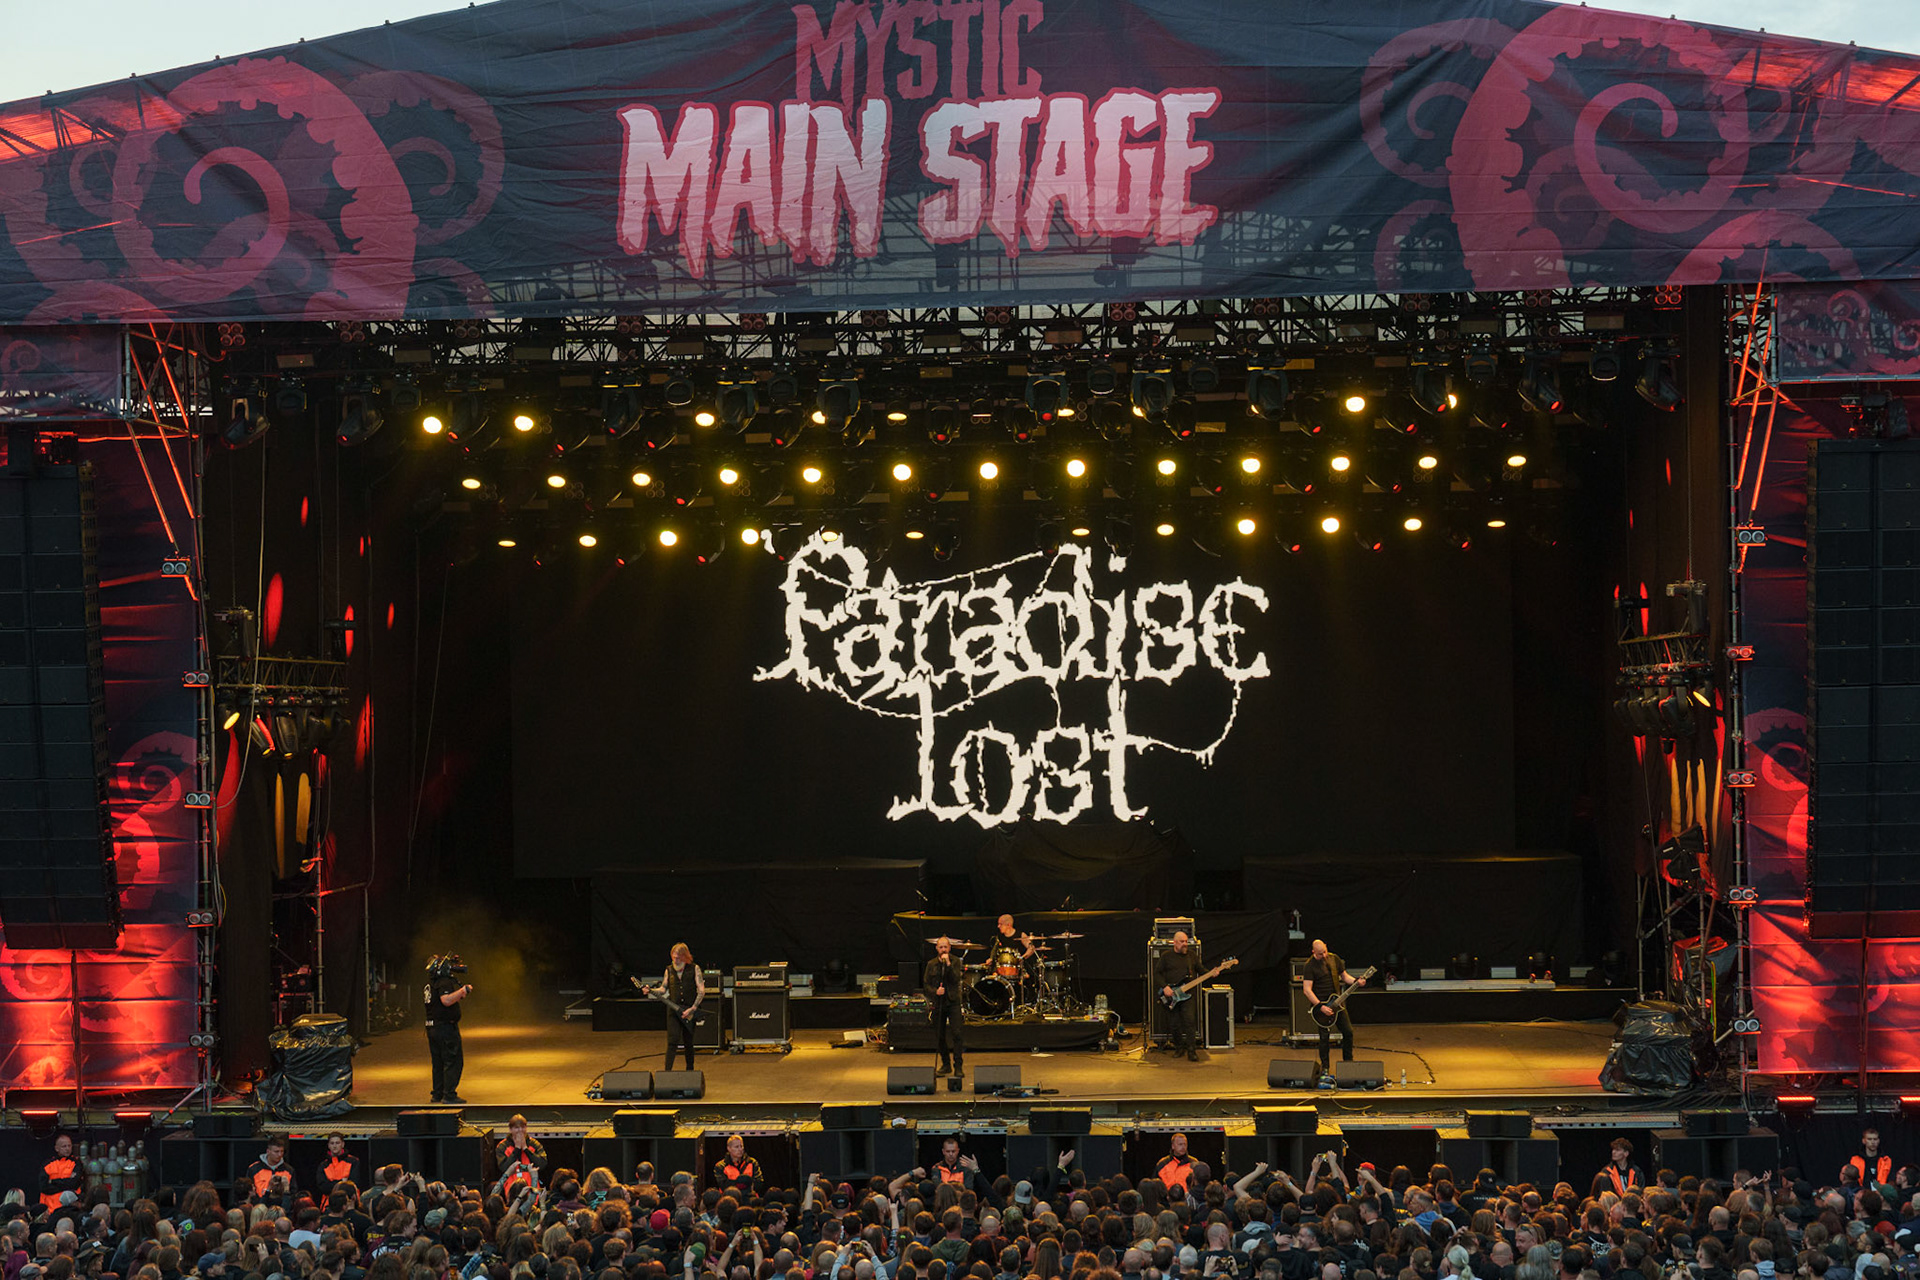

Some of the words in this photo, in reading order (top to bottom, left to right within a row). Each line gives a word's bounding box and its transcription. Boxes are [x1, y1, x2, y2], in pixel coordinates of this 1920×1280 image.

[791, 0, 1044, 106] MYSTIC
[616, 98, 893, 278] MAIN
[917, 87, 1221, 257] STAGE
[886, 668, 1150, 829] Lost
